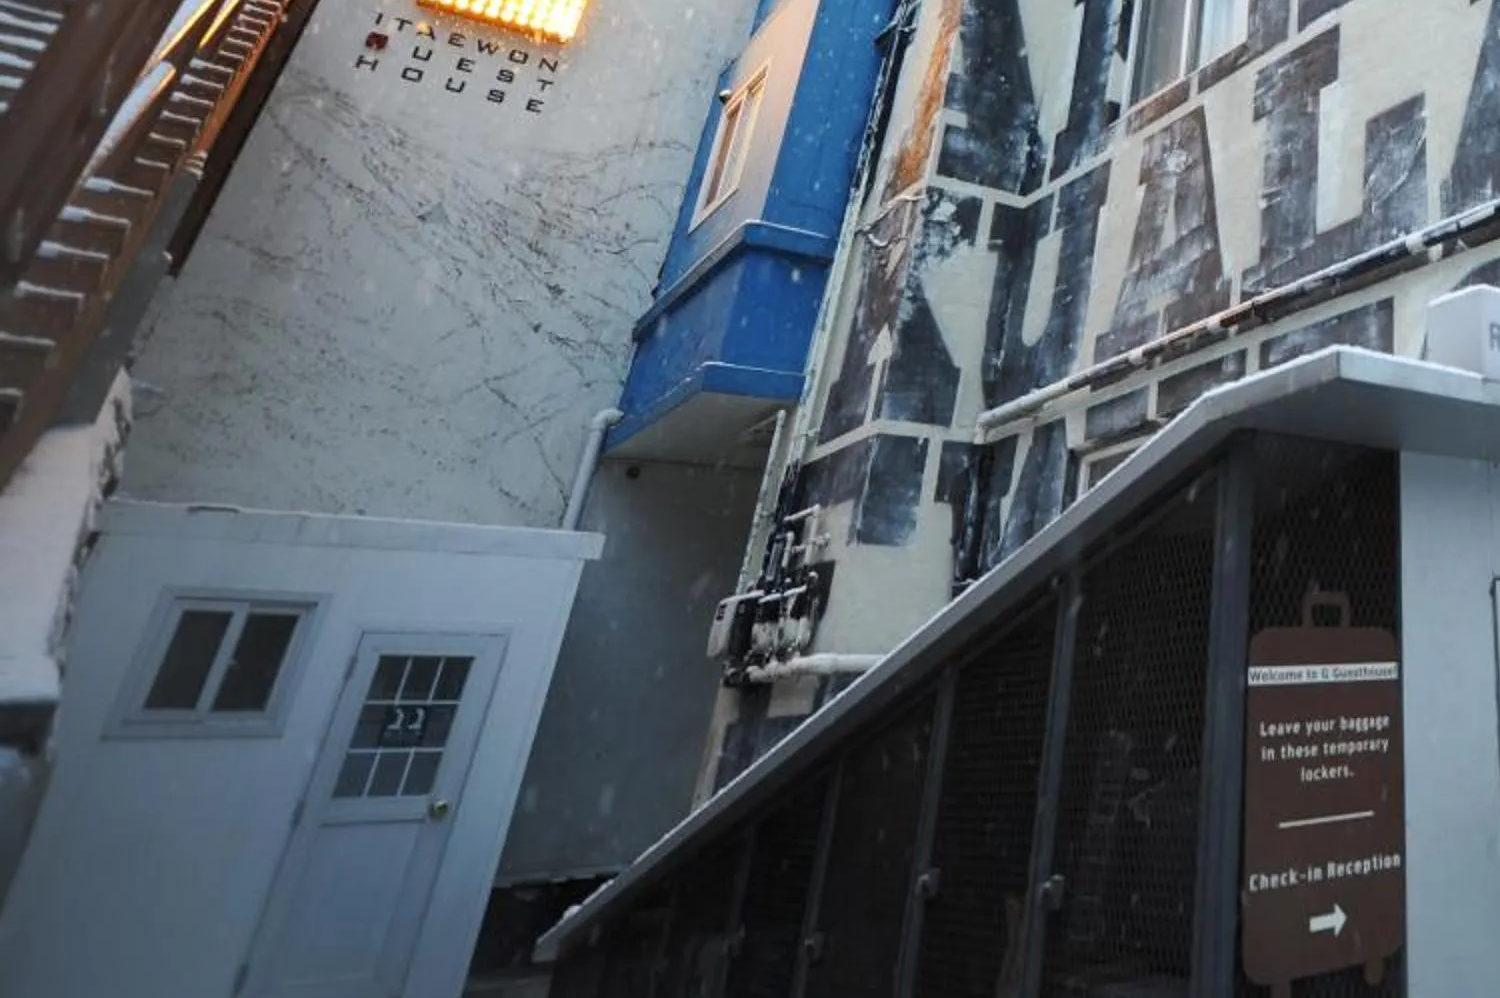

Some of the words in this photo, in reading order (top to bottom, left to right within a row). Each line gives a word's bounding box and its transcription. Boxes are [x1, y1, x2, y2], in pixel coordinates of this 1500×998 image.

[374, 12, 559, 73] ITAEWON
[355, 54, 545, 114] HOUSE
[1251, 667, 1303, 683] Welcome
[1306, 668, 1317, 680] to
[1259, 720, 1301, 737] Leave
[1305, 719, 1336, 737] your
[1339, 715, 1390, 733] baggage
[1261, 746, 1275, 761] in
[1280, 742, 1319, 760] these
[1323, 737, 1389, 757] temporary
[1300, 765, 1354, 783] lockers.
[1249, 866, 1323, 892] Check-in
[1327, 853, 1401, 879] Reception
